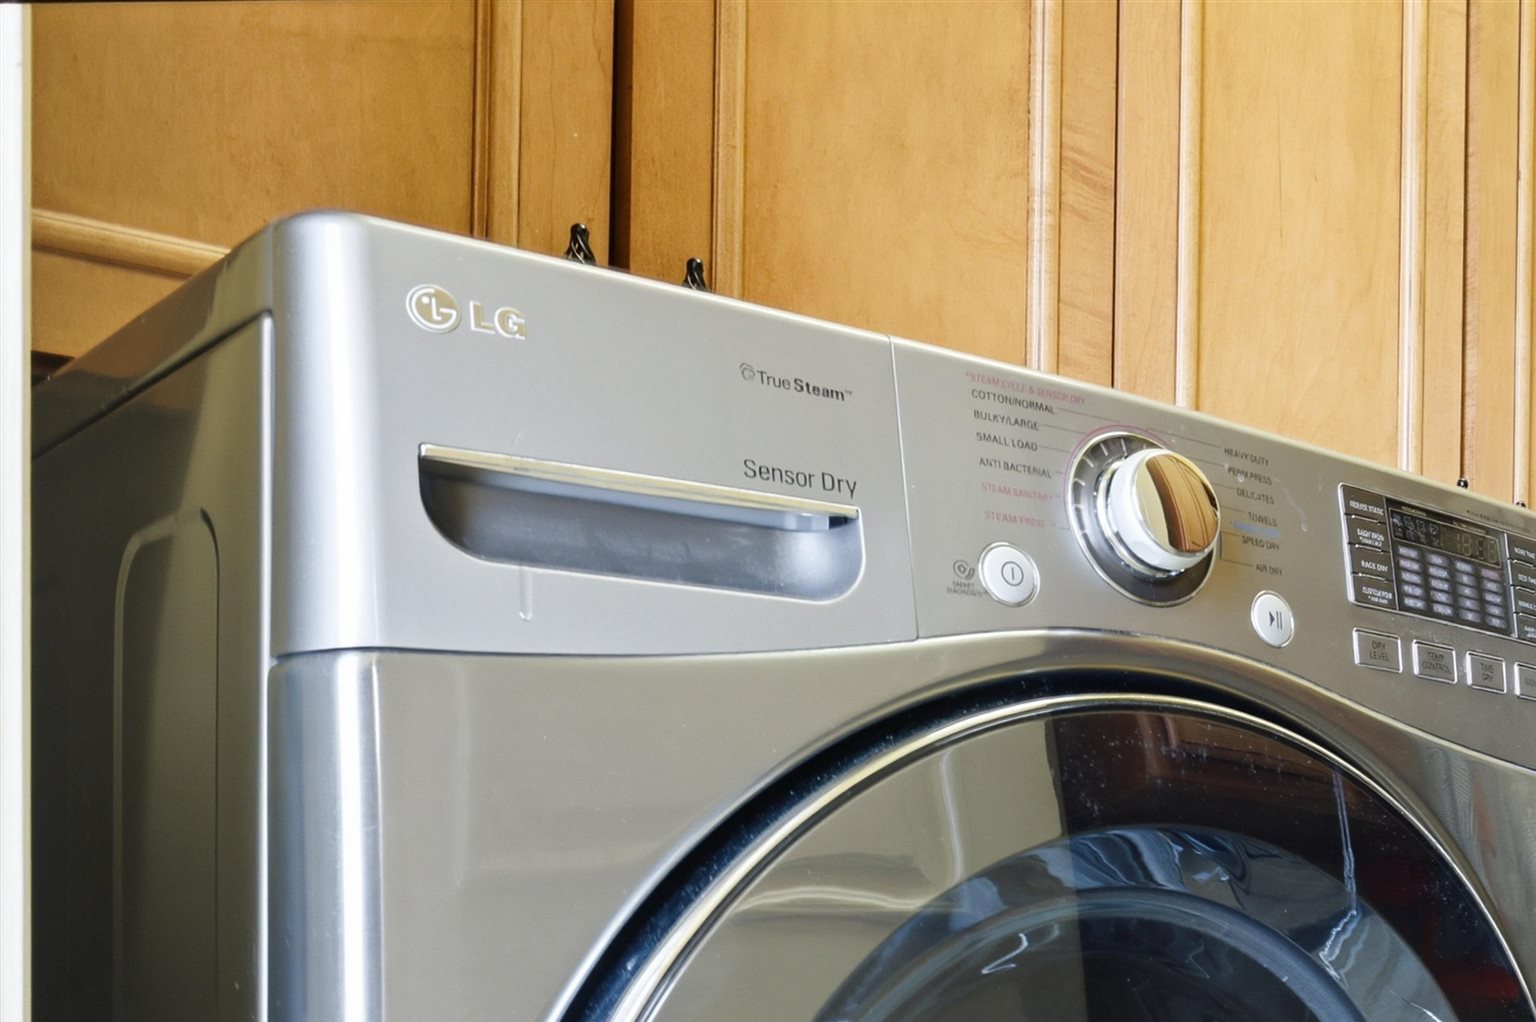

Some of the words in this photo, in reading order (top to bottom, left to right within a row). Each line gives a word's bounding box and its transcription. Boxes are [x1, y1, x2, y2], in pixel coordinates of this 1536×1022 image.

[468, 300, 527, 340] LG
[757, 369, 791, 390] True
[793, 378, 845, 401] Steam
[973, 409, 1040, 431] BULKY/LARGE
[976, 431, 1009, 447] SMALL
[1011, 439, 1038, 452] LOAD
[743, 458, 815, 488] Sensor
[821, 472, 857, 499] Dry
[979, 457, 1001, 469] ANTI
[1003, 463, 1052, 479] BACTERIAL
[1236, 487, 1275, 505] DELICATES
[1369, 650, 1390, 662] LEVEL
